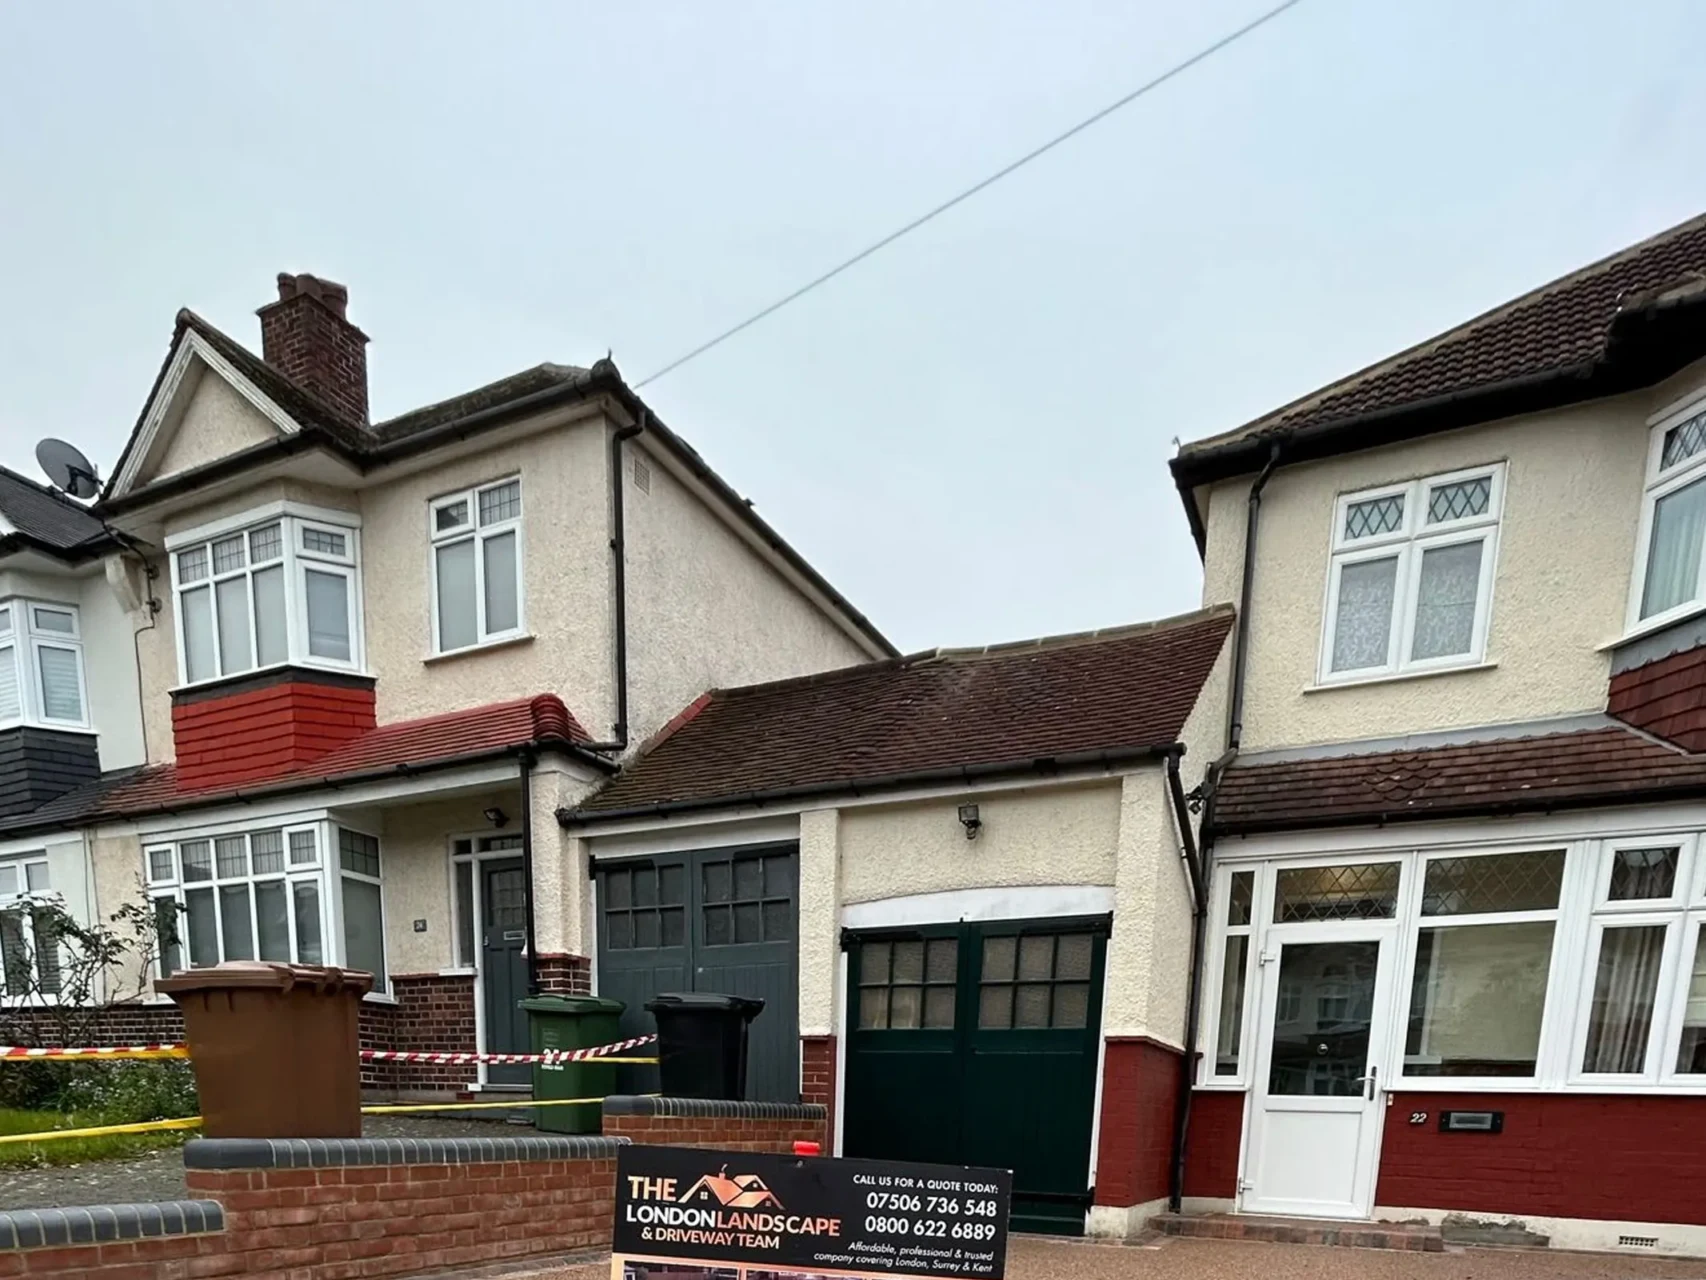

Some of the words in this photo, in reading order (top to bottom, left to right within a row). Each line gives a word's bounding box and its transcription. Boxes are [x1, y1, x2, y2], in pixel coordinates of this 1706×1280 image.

[1409, 1112, 1427, 1123] 22
[627, 1175, 678, 1202] THE
[853, 1174, 876, 1186] CALL
[878, 1176, 892, 1187] US
[894, 1177, 914, 1188] FOR
[916, 1179, 924, 1188] A
[927, 1180, 961, 1192] QUOTE
[963, 1182, 999, 1195] TODAY:
[866, 1192, 921, 1212] 07506
[926, 1196, 959, 1215] 736
[964, 1199, 997, 1218] 548
[641, 1226, 653, 1240] &
[655, 1227, 736, 1246] DRIVEWAY
[737, 1233, 780, 1250] TEAM
[865, 1215, 909, 1234] 0800
[913, 1219, 947, 1237] 622
[951, 1222, 996, 1241] 6889
[848, 1241, 896, 1255] Affordable,
[899, 1245, 953, 1259] professional
[954, 1249, 962, 1258] &
[964, 1250, 994, 1262] trusted
[813, 1253, 854, 1265] company
[855, 1254, 893, 1268] covering
[895, 1255, 930, 1269] London,
[932, 1259, 961, 1272] Surrey
[962, 1261, 970, 1271] &
[972, 1262, 993, 1273] Kent
